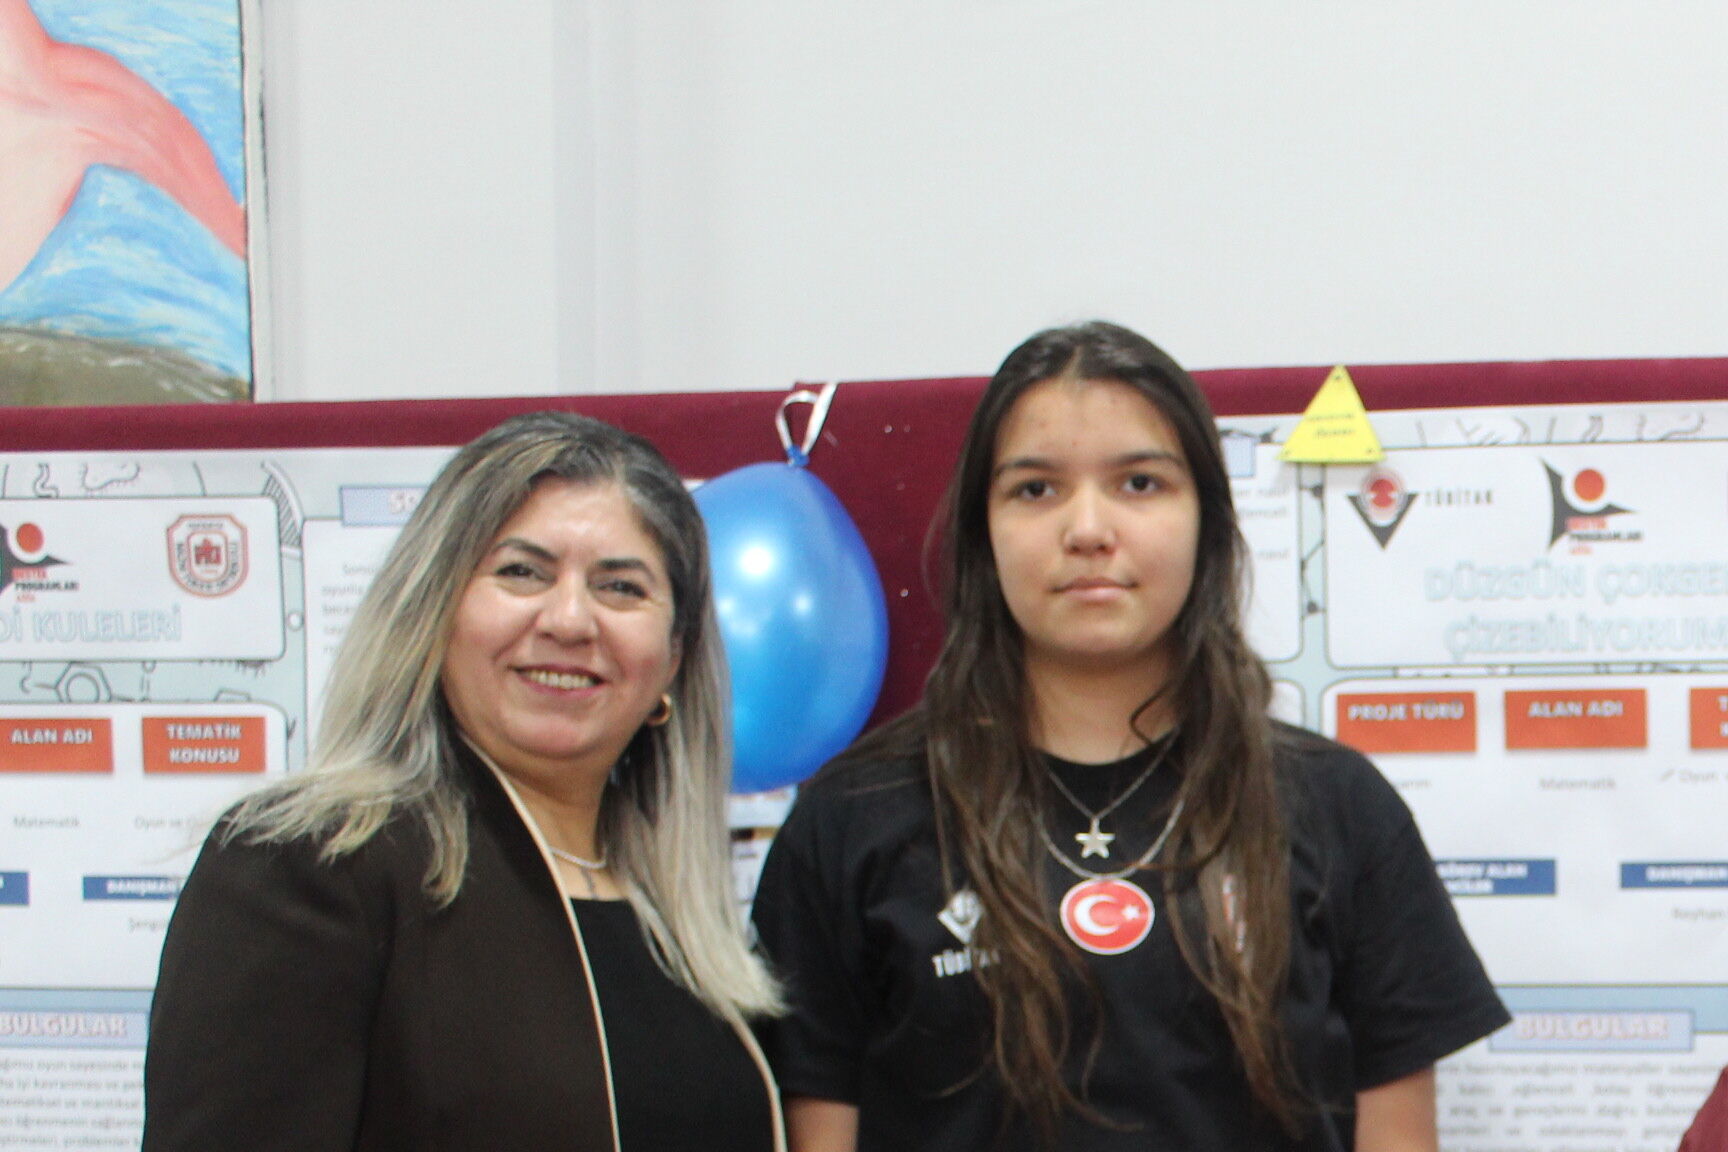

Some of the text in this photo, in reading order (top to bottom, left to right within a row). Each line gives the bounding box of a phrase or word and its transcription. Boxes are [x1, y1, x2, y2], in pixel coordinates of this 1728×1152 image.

[1423, 560, 1586, 603] DÜZGÜN
[1348, 699, 1465, 721] PROJE TÜRÜ
[1527, 700, 1624, 719] ALAN ADI
[12, 728, 92, 744] ALAN ADI
[166, 722, 242, 740] TEMATİK
[168, 748, 241, 764] KONUSU
[1514, 1014, 1671, 1041] BULGULAR
